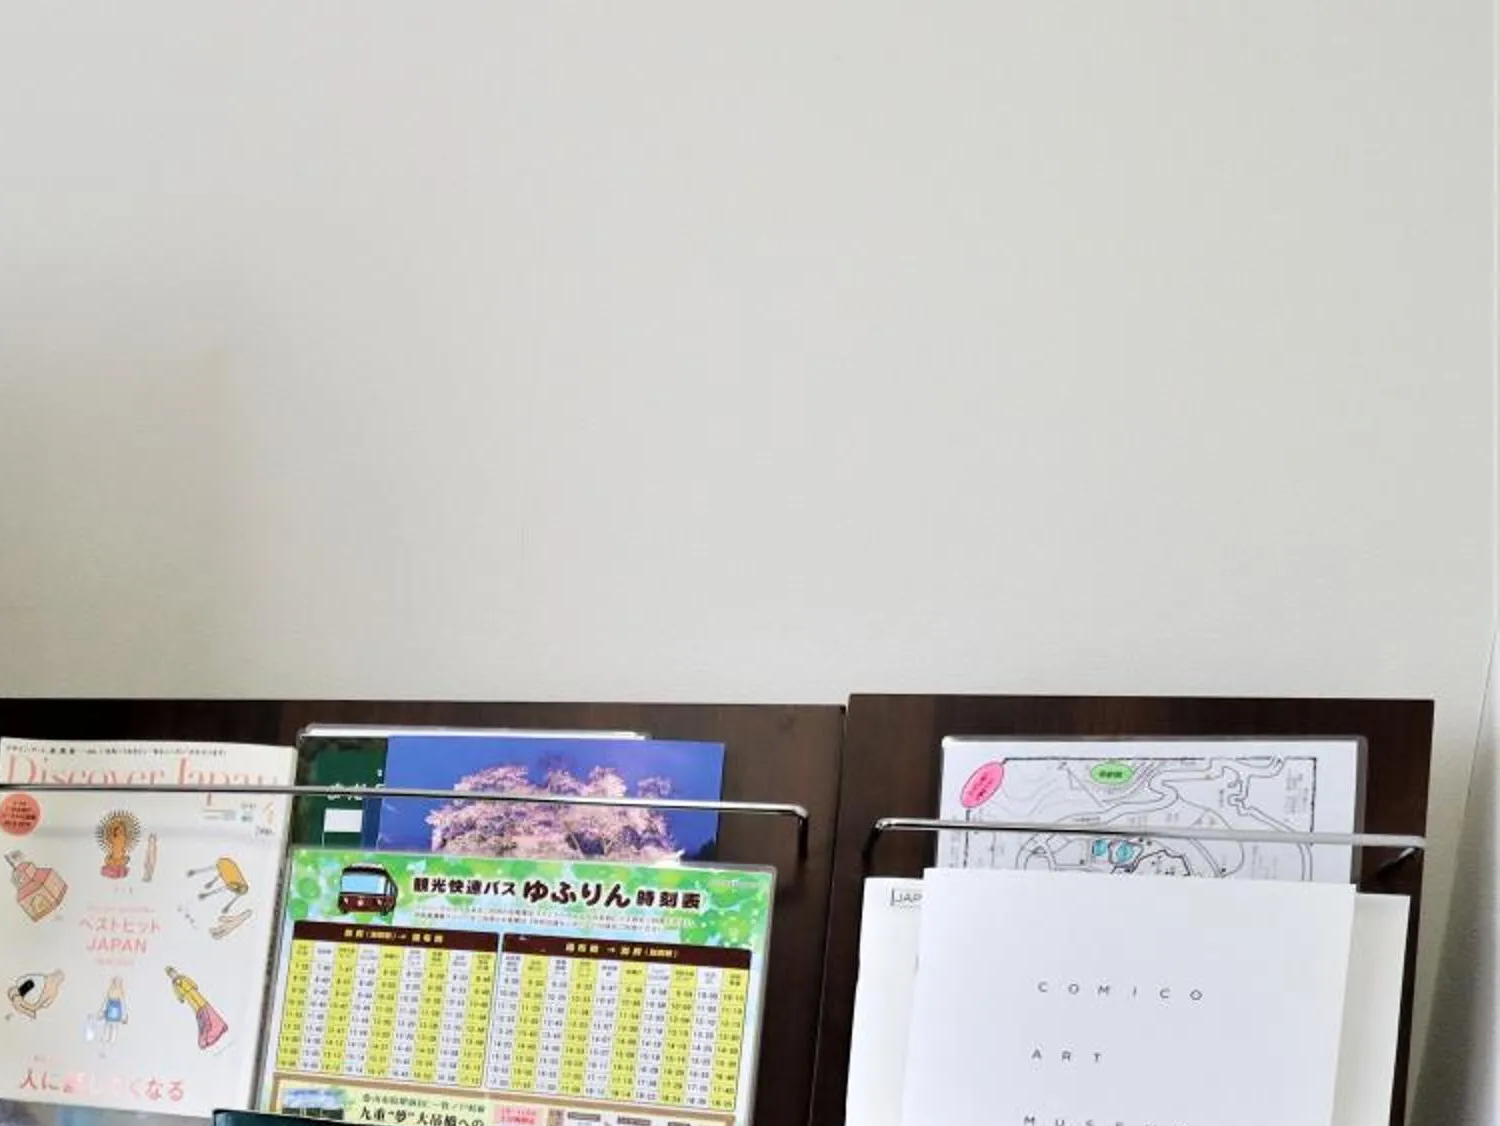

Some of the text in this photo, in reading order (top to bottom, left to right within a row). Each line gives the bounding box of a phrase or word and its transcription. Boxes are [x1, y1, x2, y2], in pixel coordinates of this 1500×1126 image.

[523, 880, 630, 908] ゆふりん
[79, 916, 161, 935] ベストヒット
[86, 937, 148, 954] JAPAN
[1037, 981, 1204, 1001] COMICO
[1031, 1048, 1103, 1063] ART
[19, 1068, 185, 1101] 人にくなる
